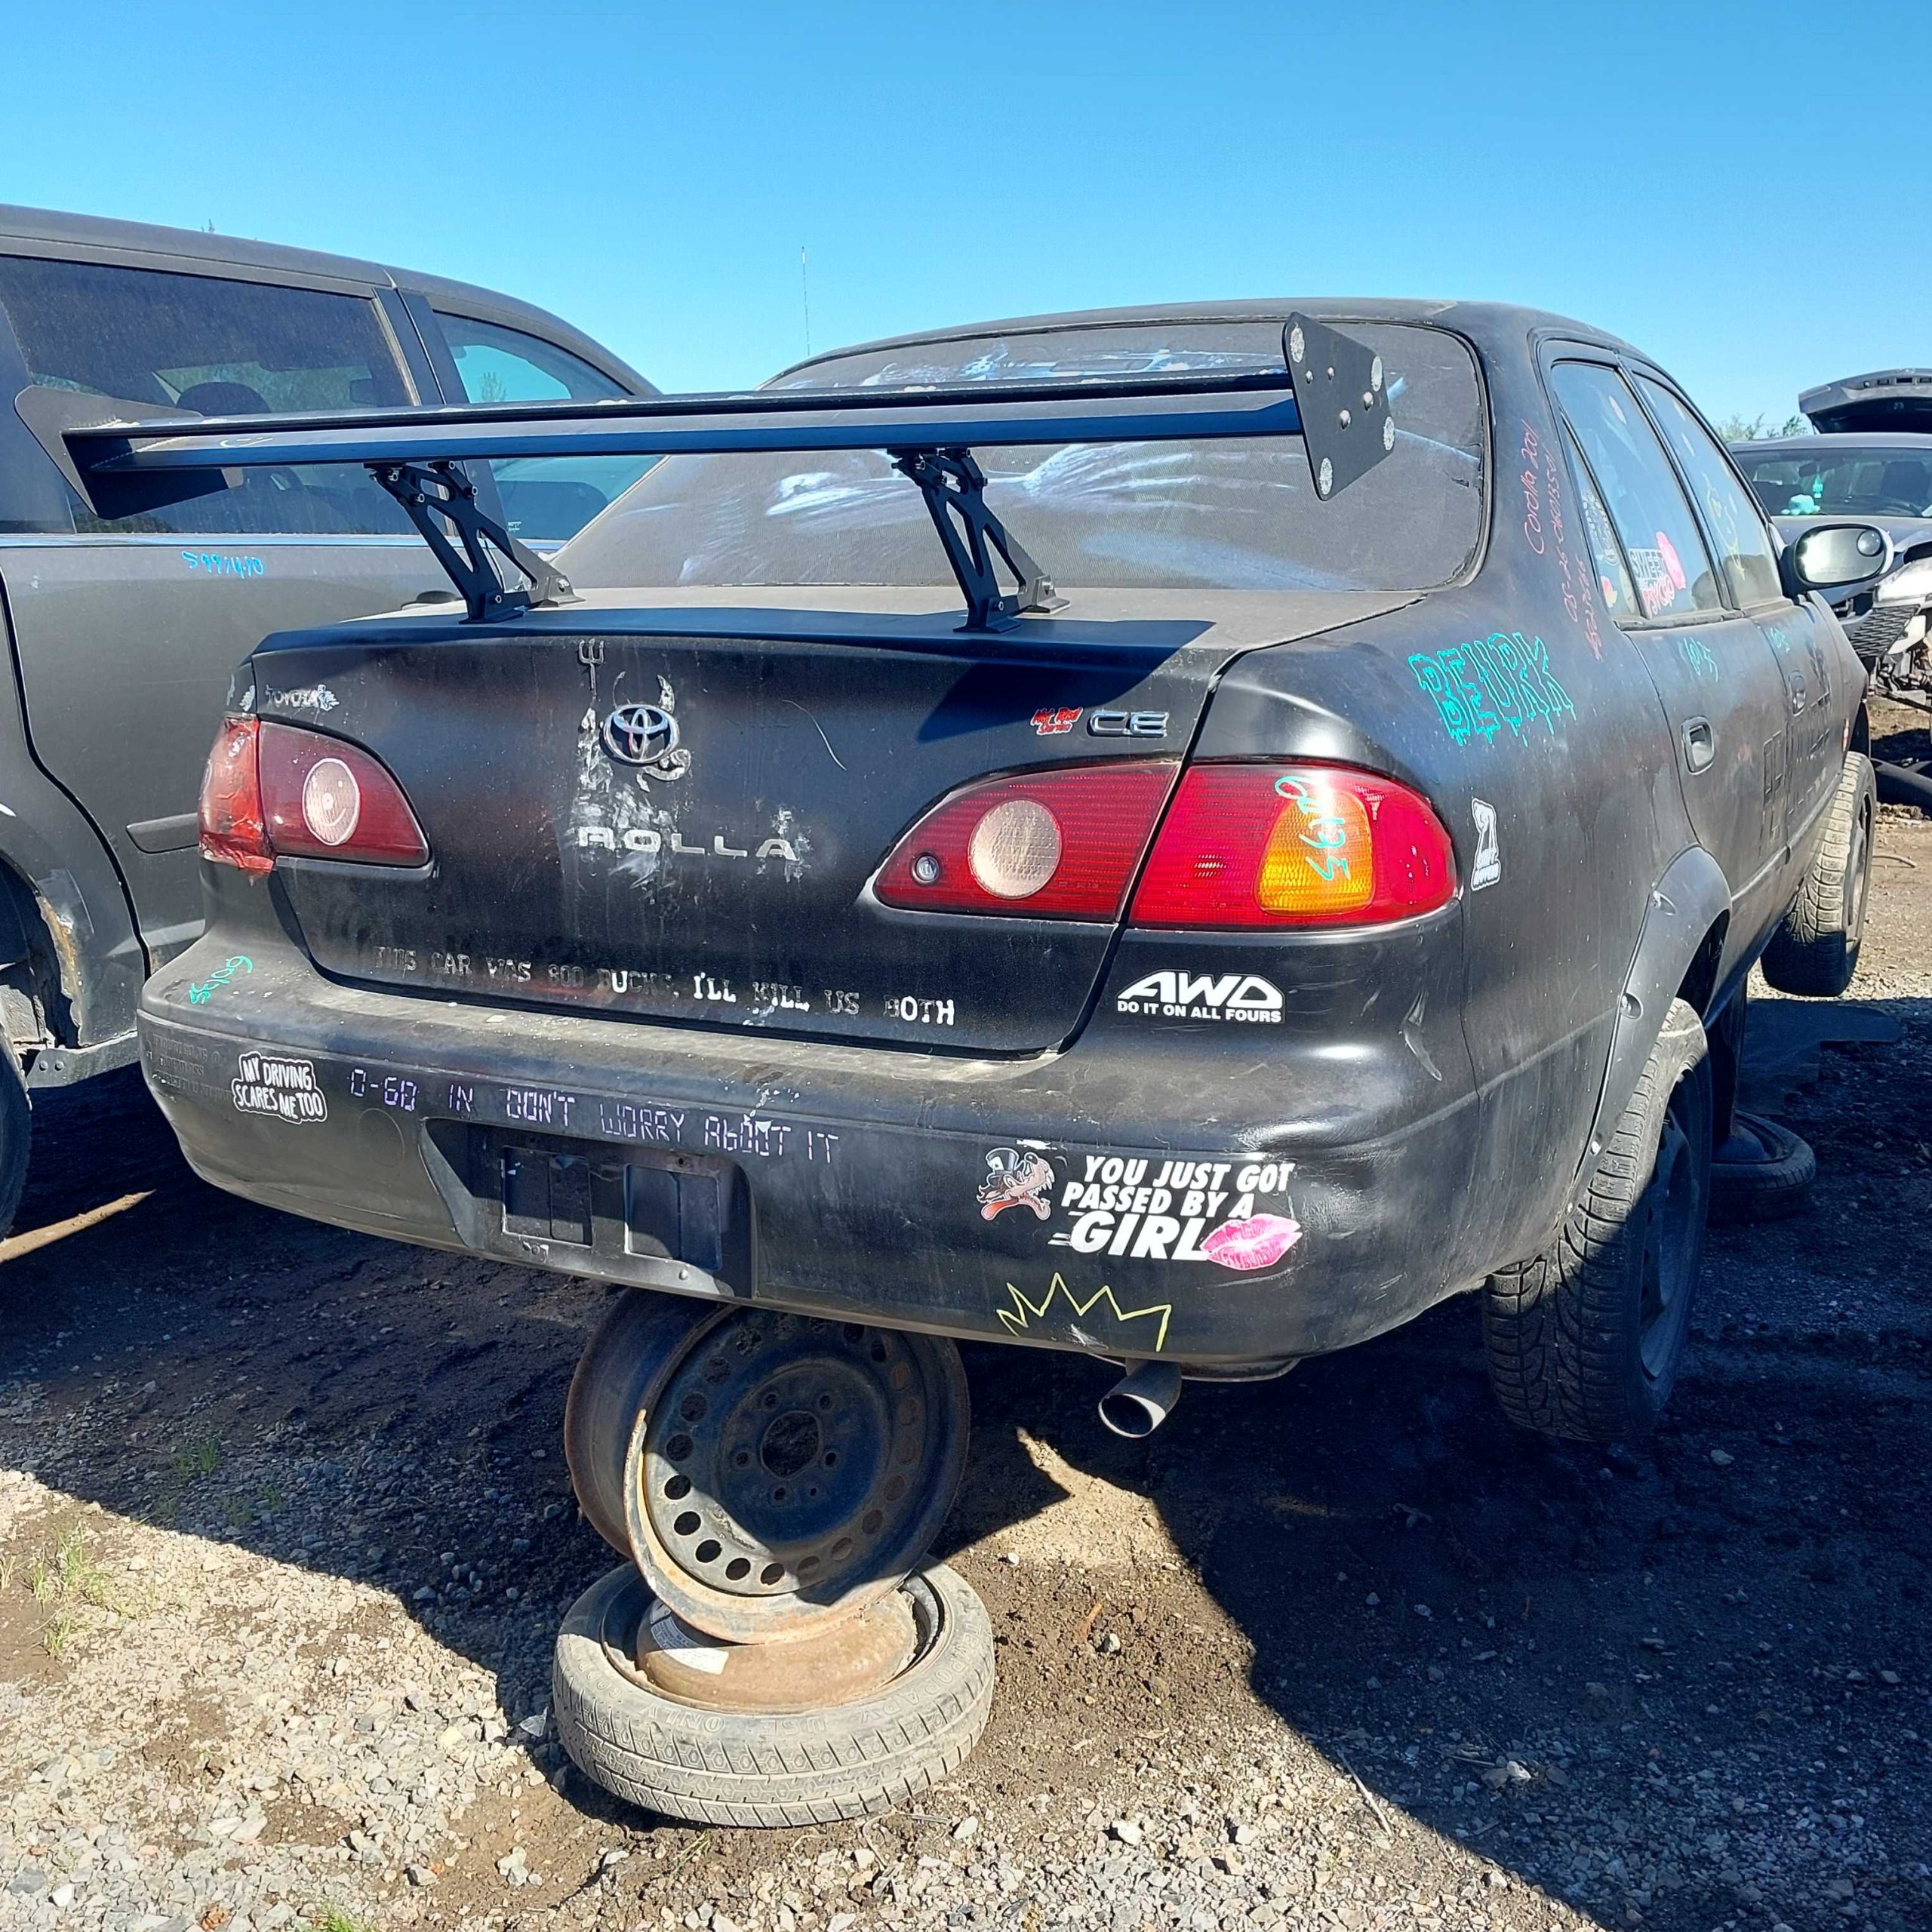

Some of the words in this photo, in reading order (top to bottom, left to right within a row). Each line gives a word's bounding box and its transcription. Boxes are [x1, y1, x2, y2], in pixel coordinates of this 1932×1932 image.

[1090, 711, 1170, 738] CE
[431, 952, 472, 977] CAR
[486, 957, 531, 982] WAS
[752, 981, 810, 1012] KILL
[824, 989, 860, 1016] US
[883, 995, 955, 1026] BOTH
[1117, 971, 1283, 1009] AWD
[1117, 1000, 1140, 1014] DO
[1143, 1002, 1159, 1015] IT
[1163, 1004, 1186, 1017] ON
[1190, 1006, 1221, 1020] ALL
[1226, 1008, 1282, 1023] FOURS
[242, 1057, 261, 1083] MY
[263, 1063, 312, 1091] DRIVING
[235, 1084, 278, 1111] SCARES
[278, 1093, 299, 1119] ME
[298, 1091, 324, 1117] TOO
[350, 1068, 417, 1112] 0-60
[449, 1084, 473, 1113] IN
[506, 1090, 575, 1127] DON'T
[599, 1103, 685, 1143] WORRY
[808, 1131, 839, 1164] IT
[1083, 1155, 1149, 1186] YOU
[1152, 1161, 1232, 1191] JUST
[1235, 1162, 1297, 1193] GOT
[1060, 1181, 1172, 1215] PASSED
[1180, 1189, 1223, 1219] BY
[1226, 1193, 1256, 1220] A
[1069, 1211, 1211, 1262] GIRL
[643, 1705, 726, 1733] ONLY
[759, 1715, 827, 1735] USE
